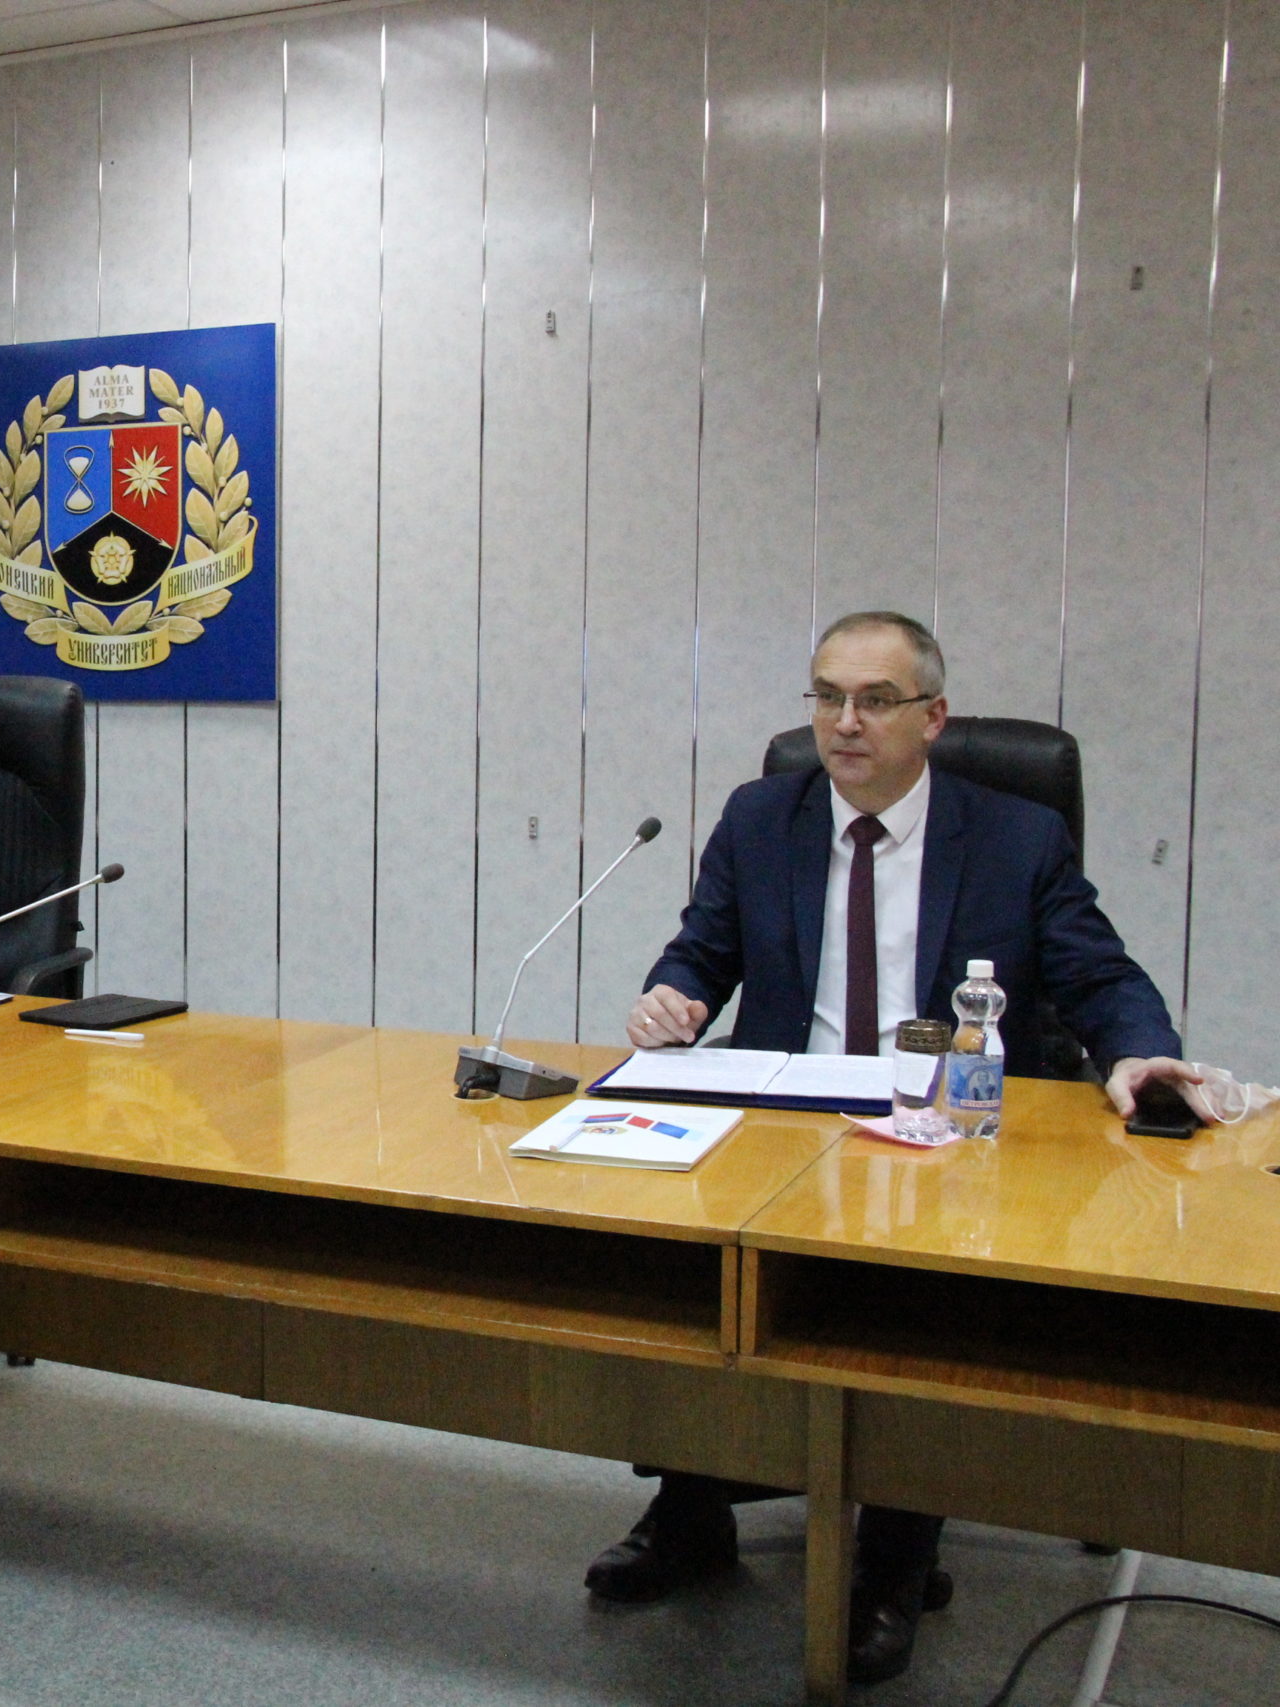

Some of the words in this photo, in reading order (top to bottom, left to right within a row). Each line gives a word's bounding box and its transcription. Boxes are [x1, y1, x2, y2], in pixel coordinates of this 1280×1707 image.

[95, 374, 129, 386] ALMA
[89, 386, 135, 398] MATER
[98, 398, 125, 409] 1937
[68, 637, 157, 664] УНИВЕРСИТЕТ
